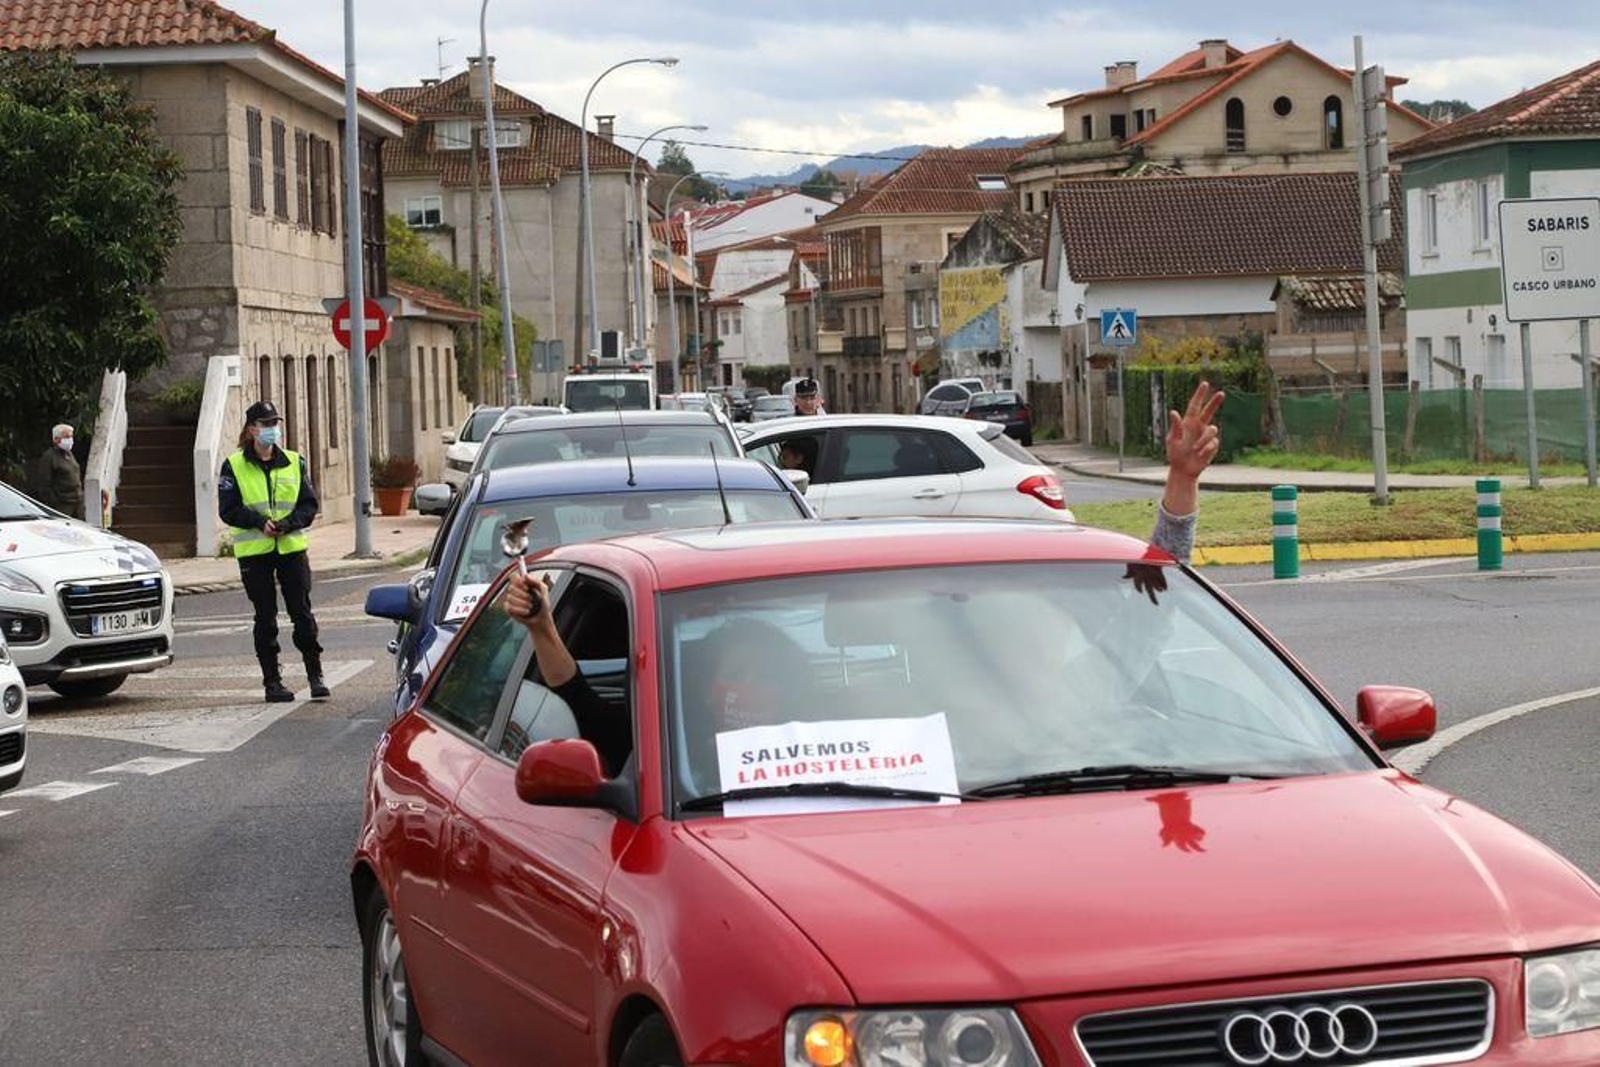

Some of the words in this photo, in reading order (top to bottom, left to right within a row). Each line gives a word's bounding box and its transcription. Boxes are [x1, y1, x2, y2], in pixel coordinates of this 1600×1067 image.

[1527, 216, 1590, 232] SABARIS
[1512, 281, 1550, 291] CASCO
[1553, 278, 1596, 290] URBANO
[102, 614, 127, 631] 1130
[741, 741, 871, 765] SALVEMOS
[738, 768, 767, 783] LA
